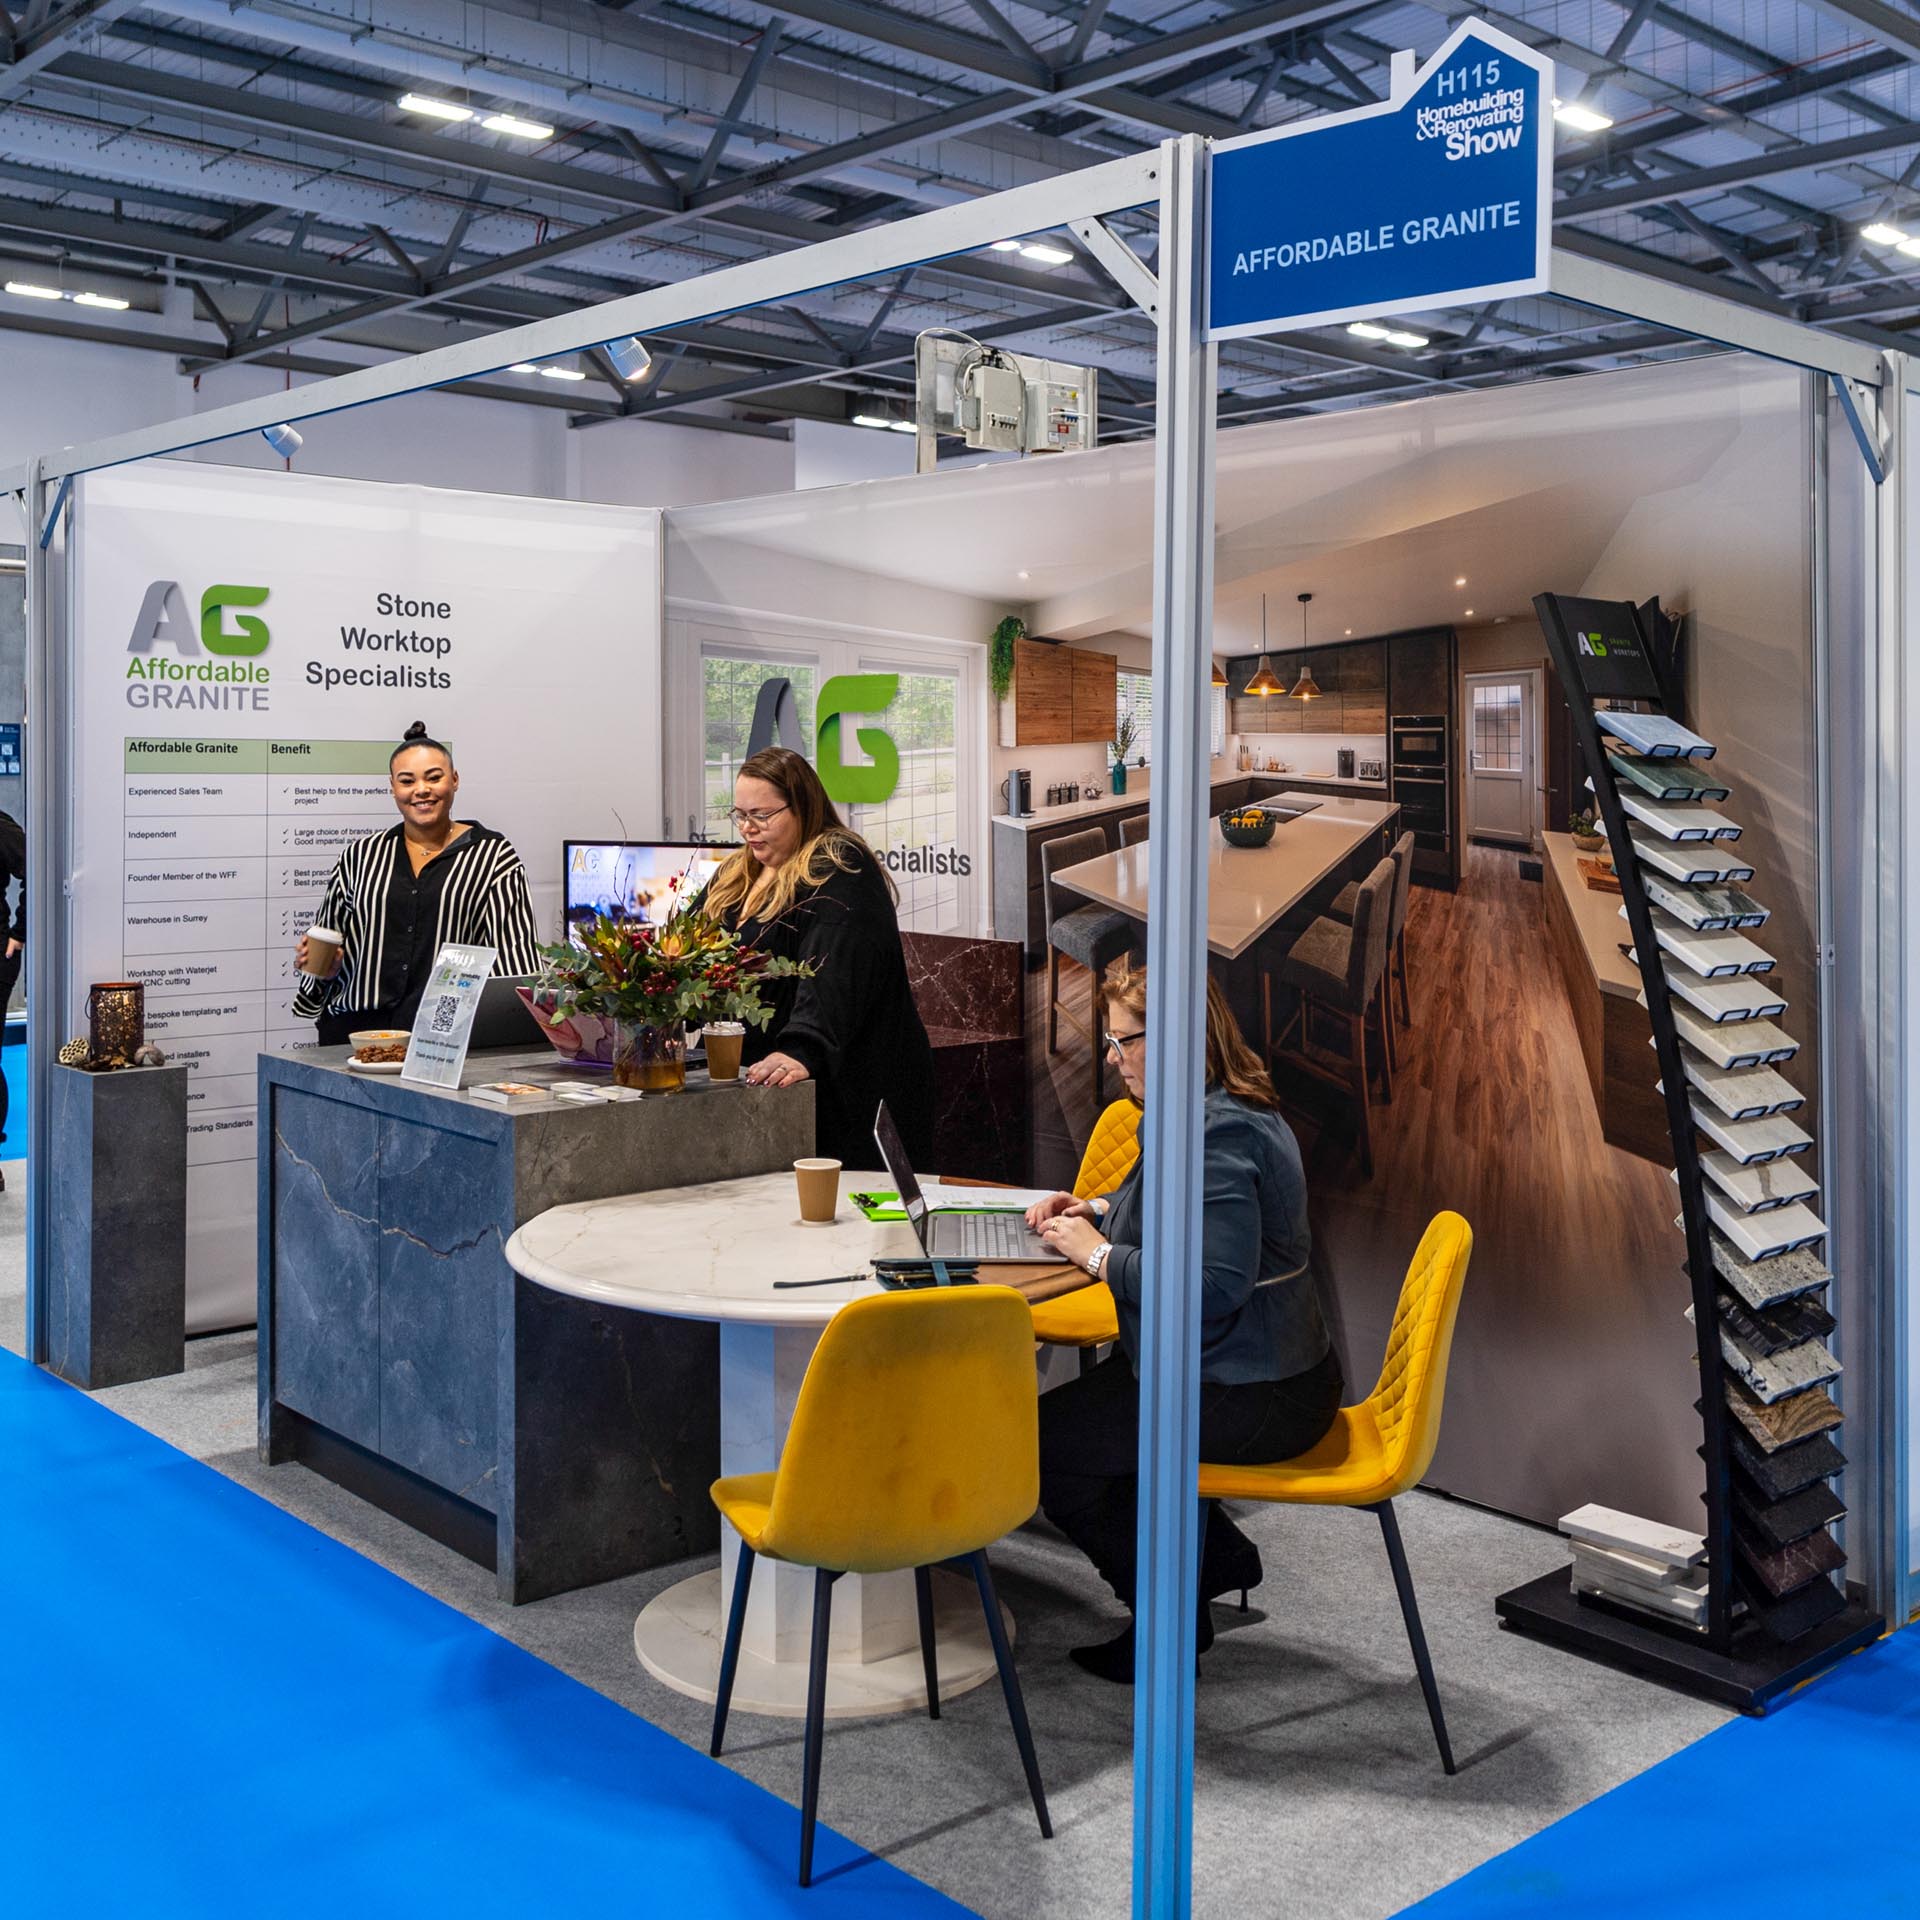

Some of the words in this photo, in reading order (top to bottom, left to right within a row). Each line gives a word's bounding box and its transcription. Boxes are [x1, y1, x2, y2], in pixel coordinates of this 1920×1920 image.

[1437, 59, 1501, 97] H115
[1417, 88, 1524, 125] Homebuilding
[1445, 125, 1522, 161] Show
[1232, 224, 1394, 276] AFFORDABLE
[1402, 200, 1520, 245] GRANITE
[376, 592, 451, 619] Stone
[127, 580, 270, 657] AG
[340, 626, 451, 660] Worktop
[1577, 631, 1607, 657] AG
[126, 656, 270, 683] Affordable
[306, 661, 451, 691] Specialists
[126, 683, 270, 711] GRANITE
[128, 741, 193, 753] Affordable
[195, 742, 239, 754] Granite
[271, 743, 311, 754] Benefit
[128, 787, 177, 796] Experienced
[178, 787, 200, 795] Sales
[202, 787, 223, 795] Team
[294, 787, 311, 795] Best
[312, 787, 328, 796] help
[329, 787, 336, 795] to
[337, 787, 351, 795] find
[352, 787, 362, 795] the
[364, 787, 388, 796] perfect
[294, 797, 319, 805] project
[128, 831, 177, 840] Independent
[294, 828, 315, 837] Large
[316, 828, 339, 836] choice
[294, 838, 314, 846] Good
[315, 837, 345, 846] impartial
[875, 844, 971, 876] ecialists
[127, 872, 161, 882] Founder
[162, 872, 194, 881] Member
[195, 871, 204, 880] of
[205, 871, 217, 880] the
[219, 870, 238, 879] WFF
[294, 869, 310, 877] Best
[294, 878, 310, 887] Best
[127, 916, 172, 925] Warehouse
[173, 915, 181, 923] in
[182, 914, 208, 924] Surrey
[293, 910, 315, 919] Large
[293, 919, 311, 927] View
[127, 969, 166, 978] Workshop
[167, 967, 184, 976] with
[185, 966, 217, 975] Waterjet
[143, 978, 163, 987] CNC
[164, 977, 191, 986] cutting
[147, 1009, 181, 1020] bespoke
[182, 1007, 221, 1018] templating
[223, 1006, 238, 1014] and
[144, 1020, 169, 1029] llation
[177, 1049, 211, 1059] installers
[186, 1124, 214, 1133] Trading
[215, 1119, 254, 1130] Standards
